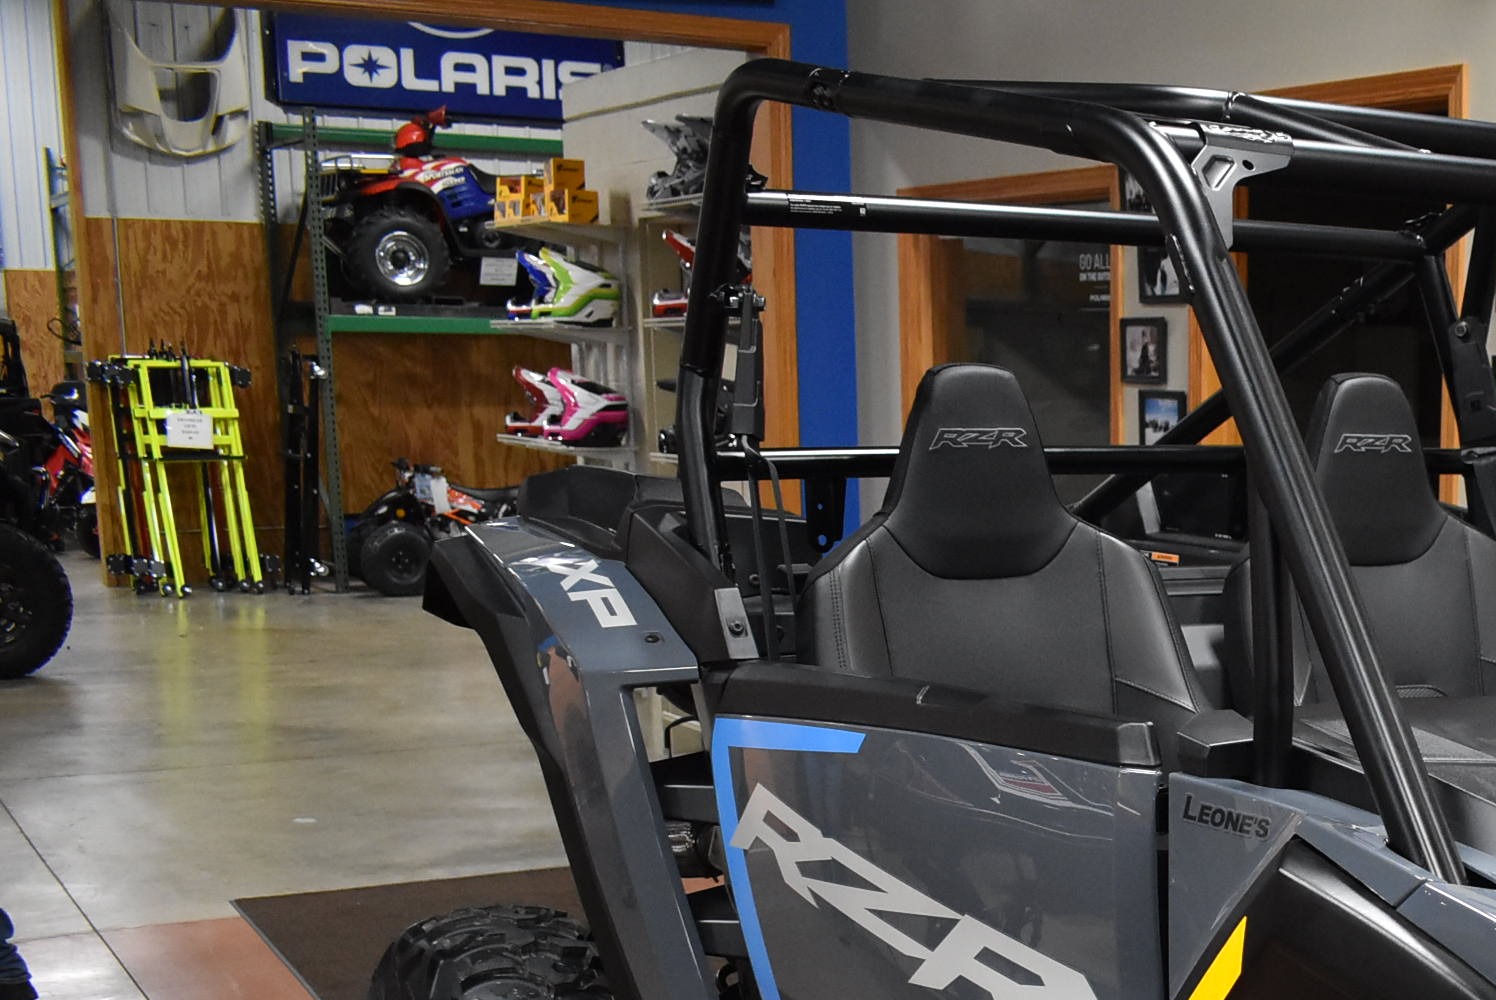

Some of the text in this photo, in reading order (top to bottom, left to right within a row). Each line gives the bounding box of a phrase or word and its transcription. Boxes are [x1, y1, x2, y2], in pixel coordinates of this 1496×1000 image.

[928, 427, 1029, 451] RZR
[1333, 433, 1413, 454] RZR
[546, 558, 638, 629] XP
